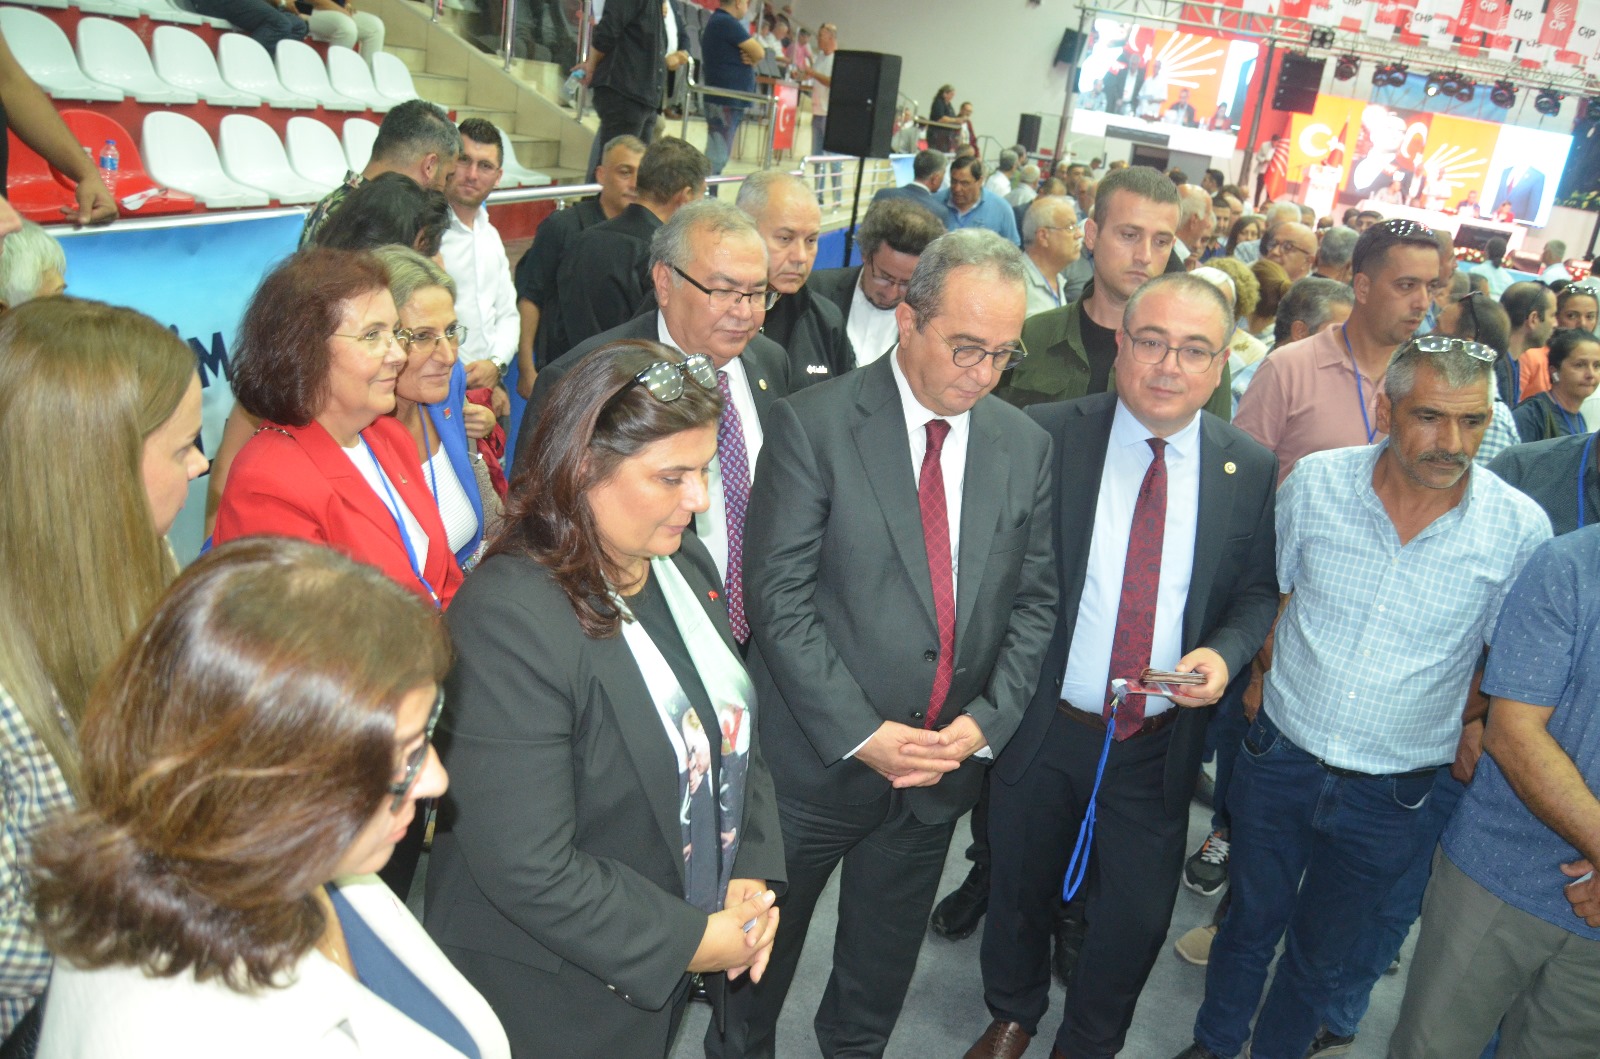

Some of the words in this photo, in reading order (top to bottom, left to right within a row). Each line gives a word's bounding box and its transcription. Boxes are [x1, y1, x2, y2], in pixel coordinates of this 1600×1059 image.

[1480, 0, 1498, 13] CHP
[1415, 12, 1433, 22] CHP
[1513, 8, 1533, 21] CHP
[1549, 19, 1567, 31] CHP
[1578, 26, 1596, 39] CHP
